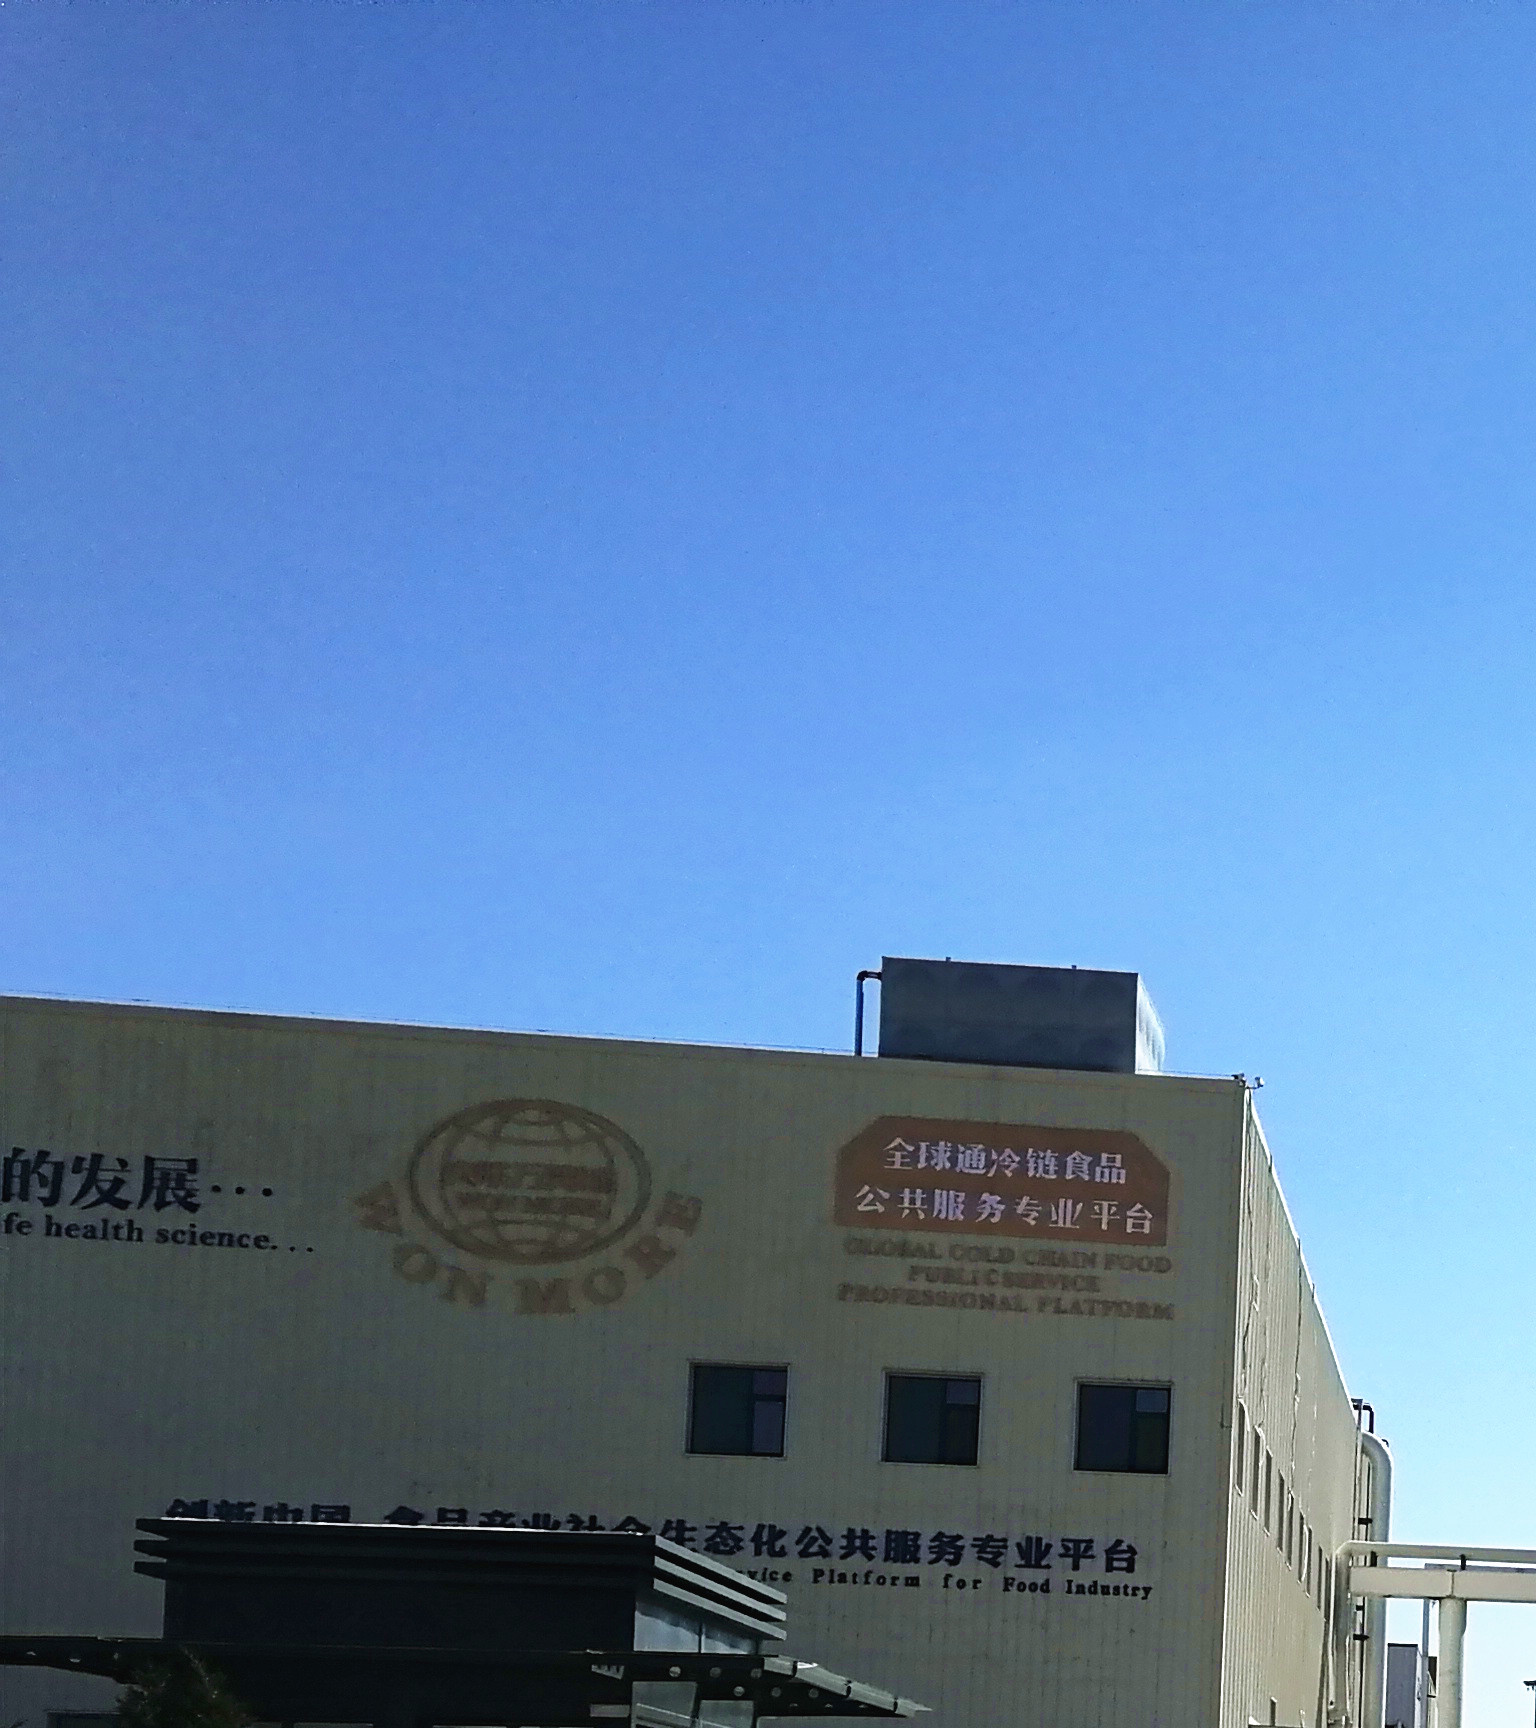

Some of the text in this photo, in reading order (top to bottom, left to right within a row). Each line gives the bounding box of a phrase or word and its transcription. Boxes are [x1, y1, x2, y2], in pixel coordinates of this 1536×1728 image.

[883, 1137, 1127, 1184] 全球通冷链食品
[854, 1184, 1153, 1235] 公共服务专业平台
[45, 1215, 143, 1243] health
[843, 1236, 1172, 1274] GLOBAL COLD CHAIN FOOD
[837, 1282, 1174, 1321] PROFESSIONAL PLATFORM
[812, 1568, 920, 1588] Platform
[943, 1573, 982, 1591] for
[1002, 1576, 1050, 1595] Food
[1065, 1579, 1153, 1600] Industry
